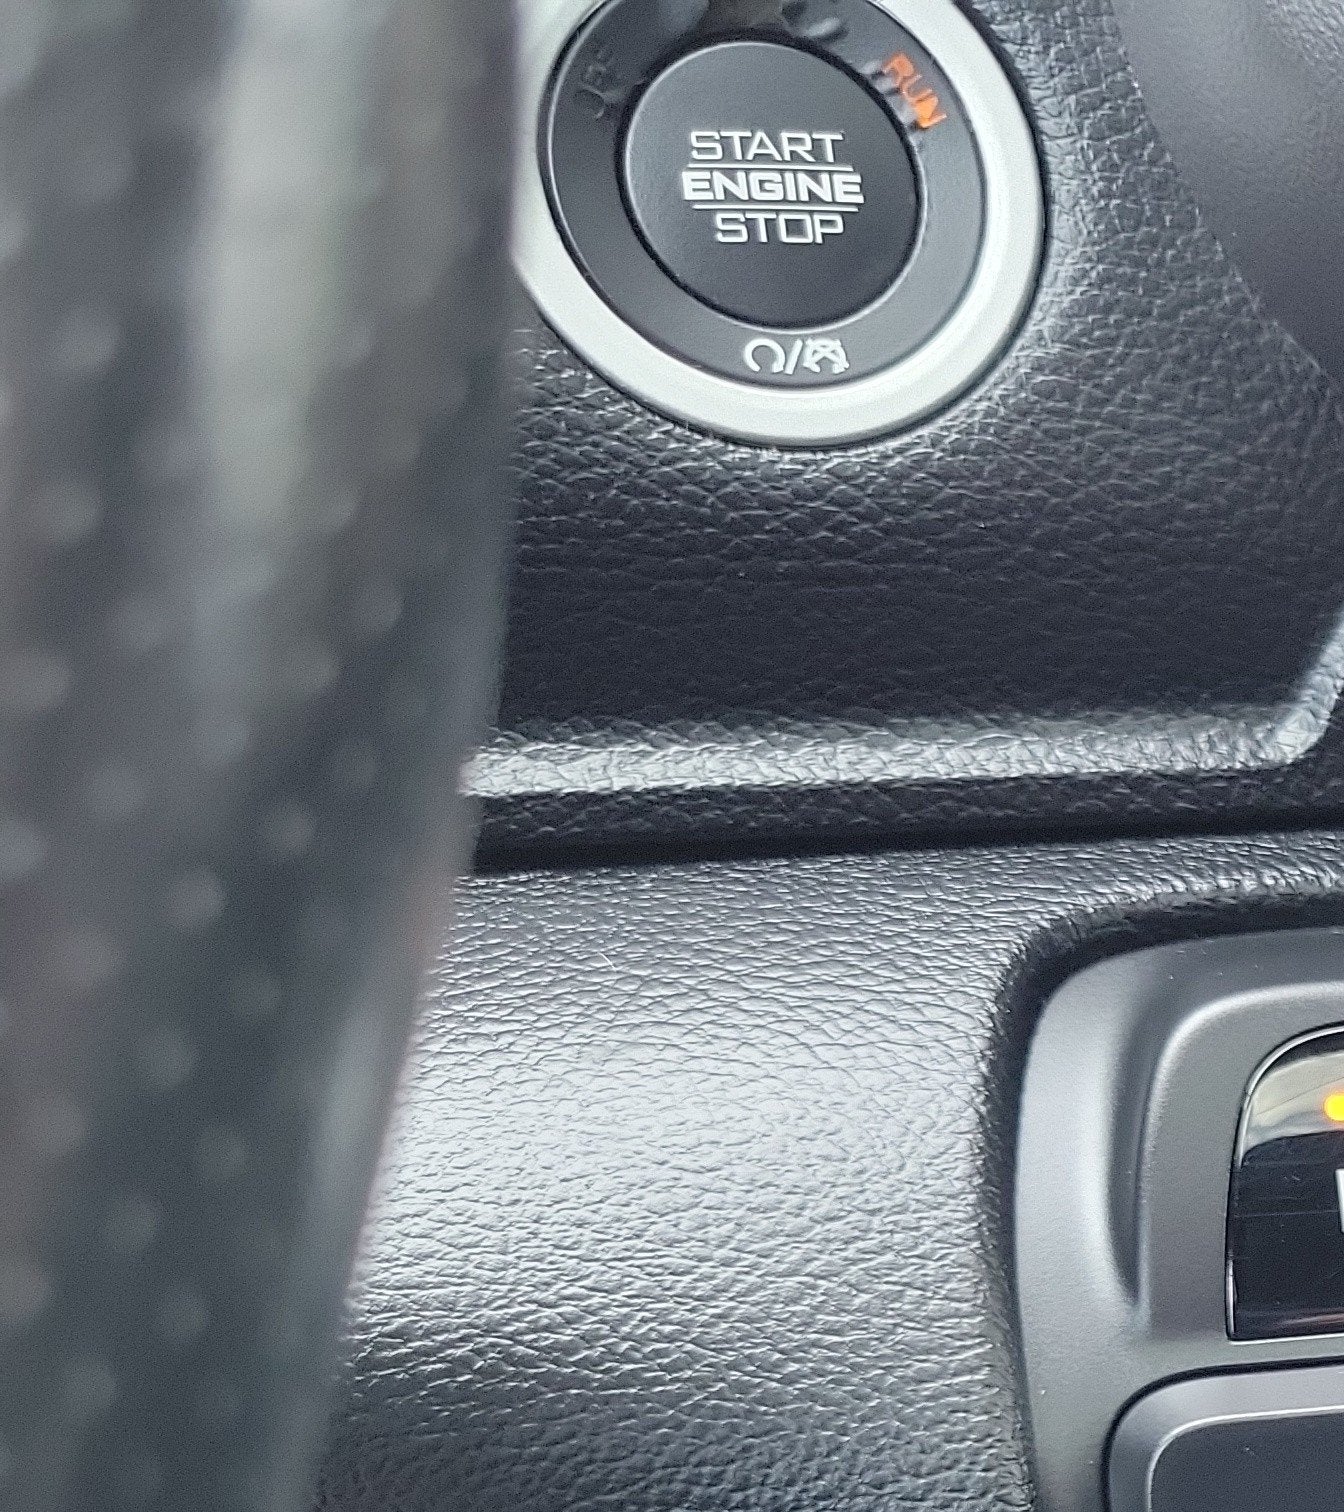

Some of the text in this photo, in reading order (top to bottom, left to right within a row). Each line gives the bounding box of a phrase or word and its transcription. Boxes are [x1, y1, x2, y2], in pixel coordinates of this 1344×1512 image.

[881, 52, 948, 131] RUN
[690, 130, 845, 163] START
[681, 170, 865, 204] ENGINE
[714, 211, 844, 243] STOP
